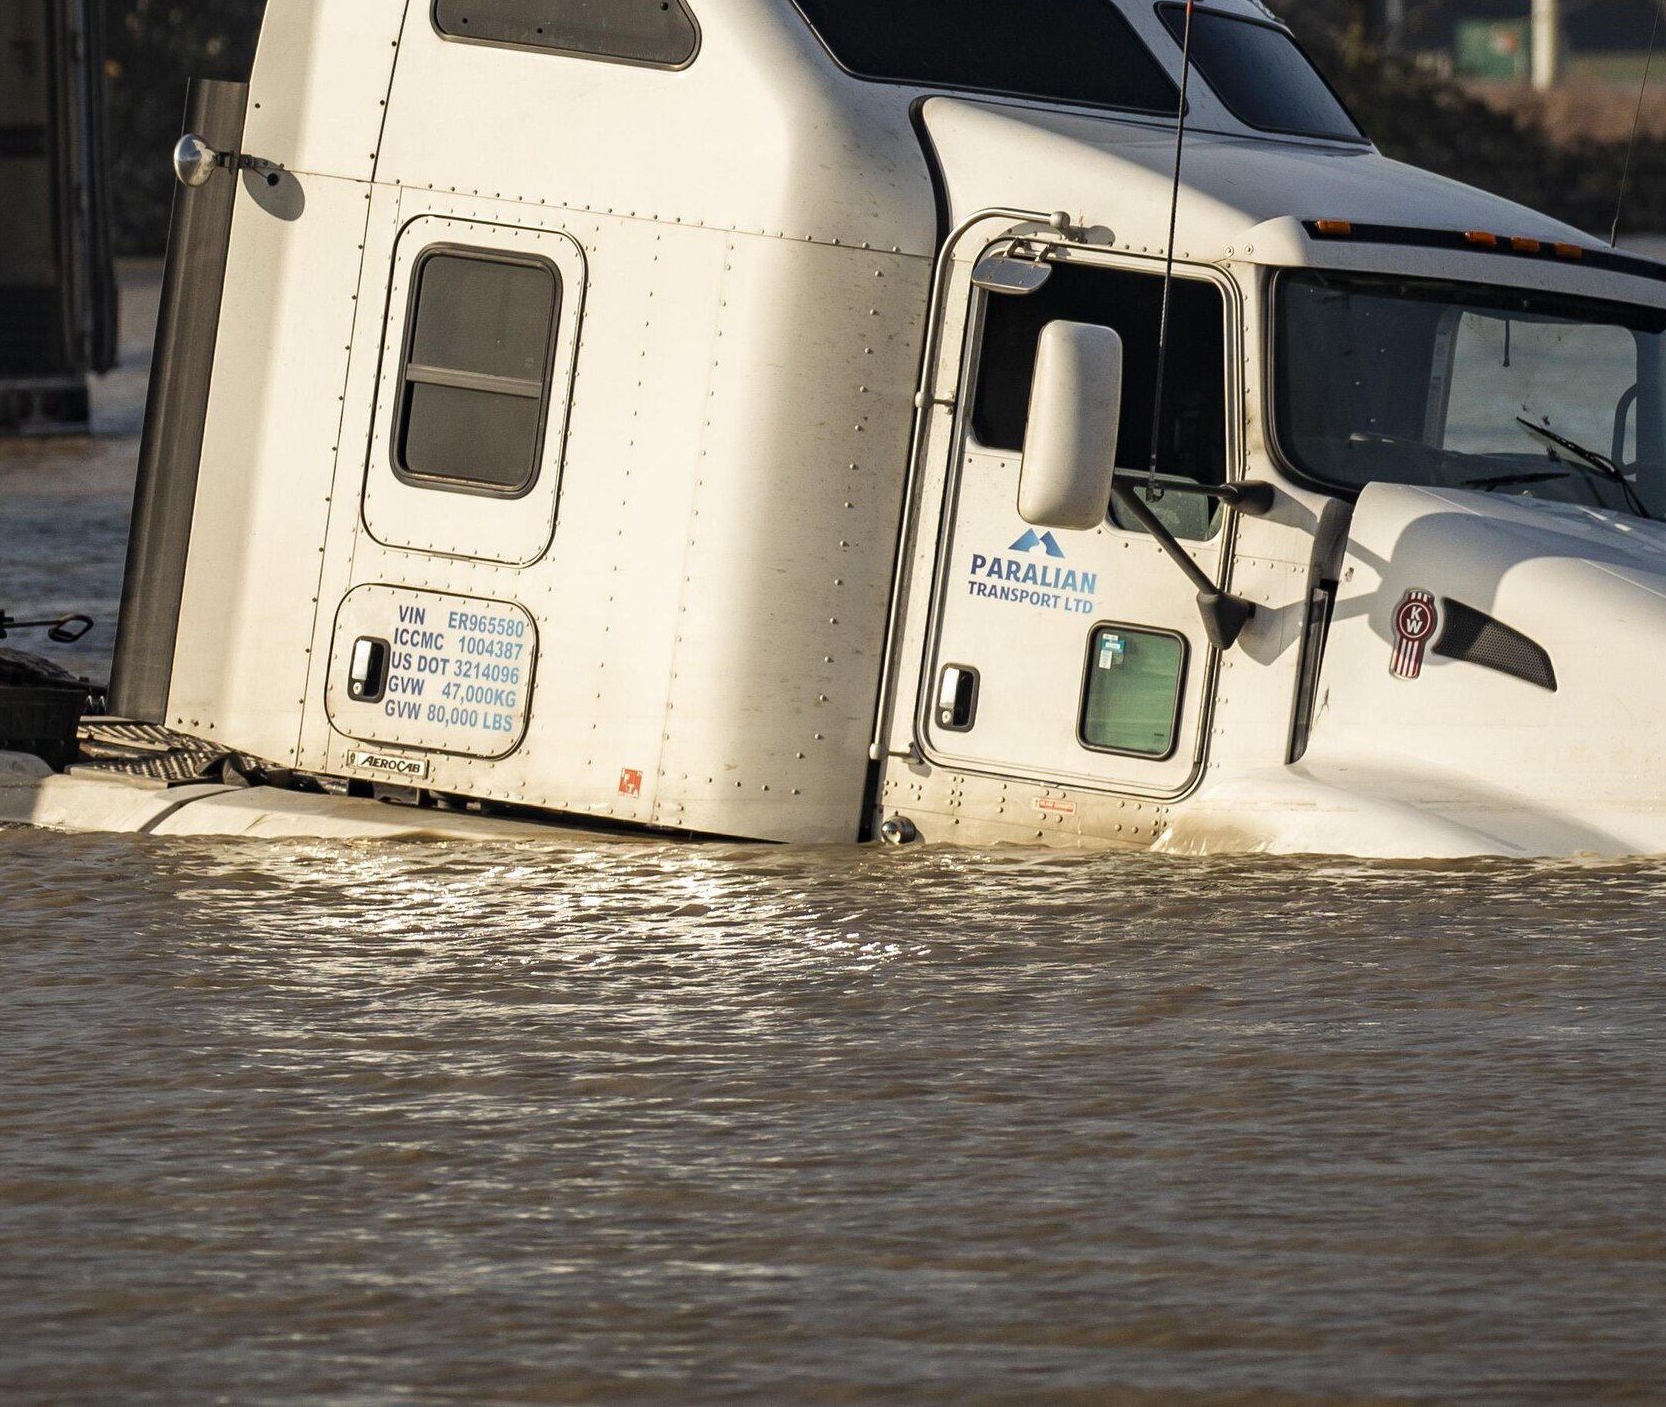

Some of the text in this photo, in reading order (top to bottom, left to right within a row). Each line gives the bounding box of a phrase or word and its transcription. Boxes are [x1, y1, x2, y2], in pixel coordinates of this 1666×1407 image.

[970, 553, 1098, 595] PARALIAN
[968, 580, 1093, 614] TRANSPORT LTD
[399, 605, 525, 638] VIN ER965580
[394, 627, 523, 661] ICCMC 1004387
[391, 651, 519, 685] US DOT 3214096
[388, 675, 517, 708] GVW 47,000KG
[385, 699, 513, 732] GVW 80,000 LBS
[361, 755, 421, 774] AEROCAB
